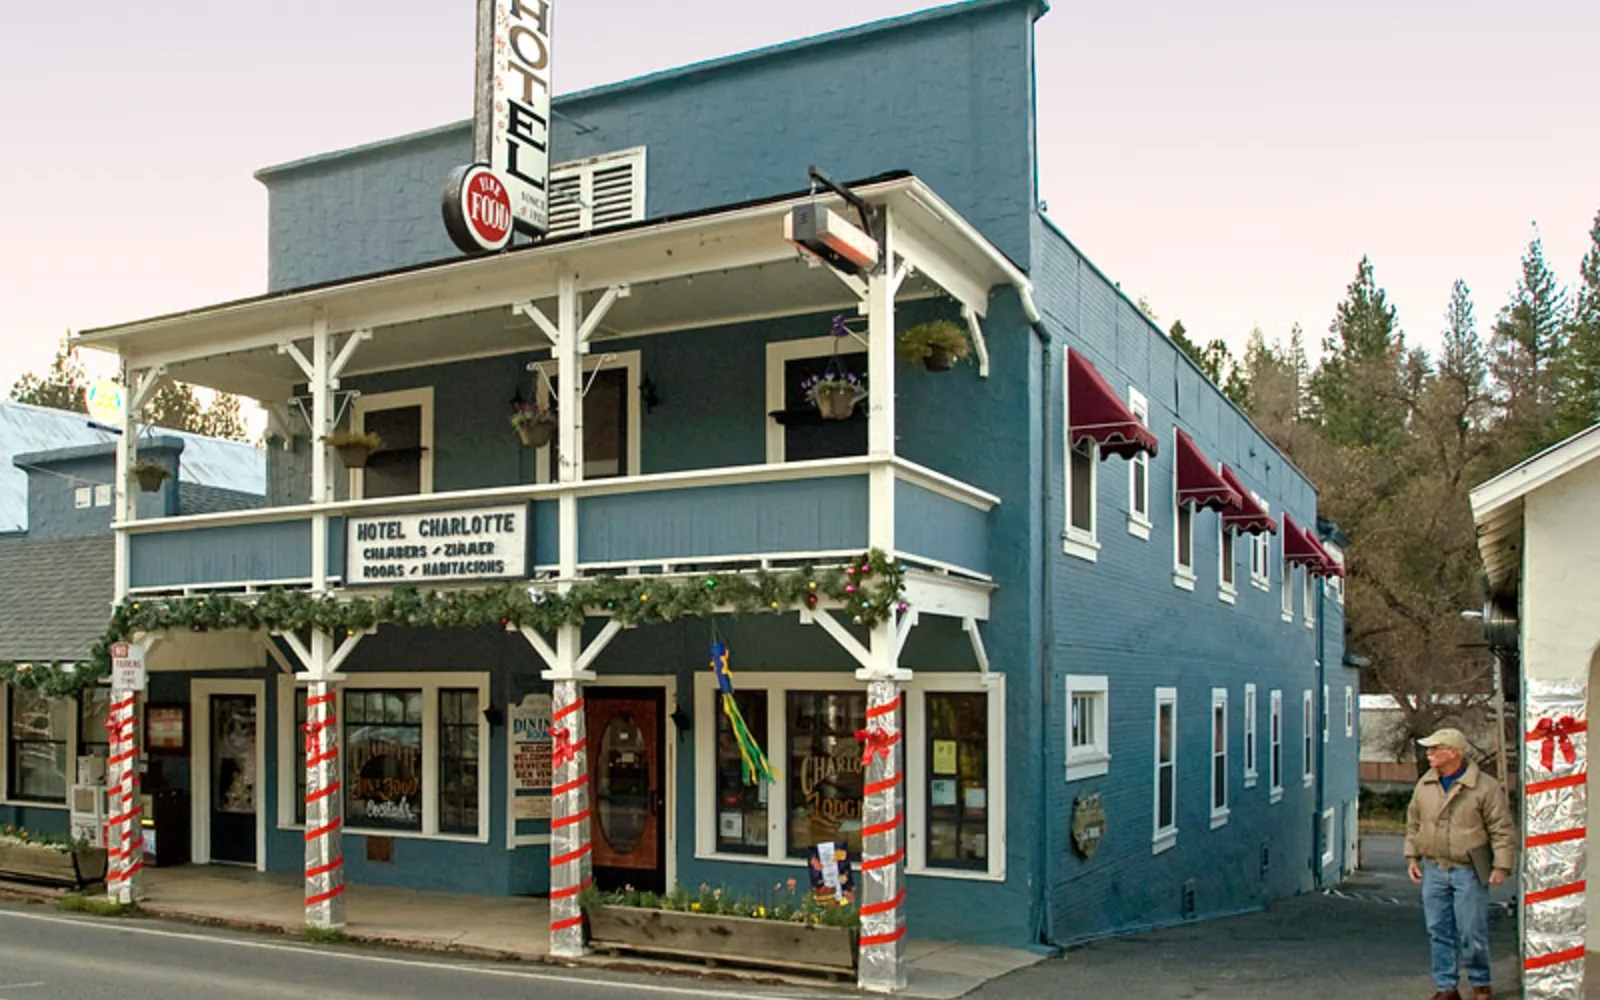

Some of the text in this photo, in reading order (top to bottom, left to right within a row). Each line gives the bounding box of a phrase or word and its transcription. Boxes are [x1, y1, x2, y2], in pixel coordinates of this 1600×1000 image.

[471, 191, 509, 231] FOOD
[357, 513, 515, 541] HOTEL CHARLOTTE
[363, 563, 404, 578] ROOMS
[513, 717, 552, 735] DININ
